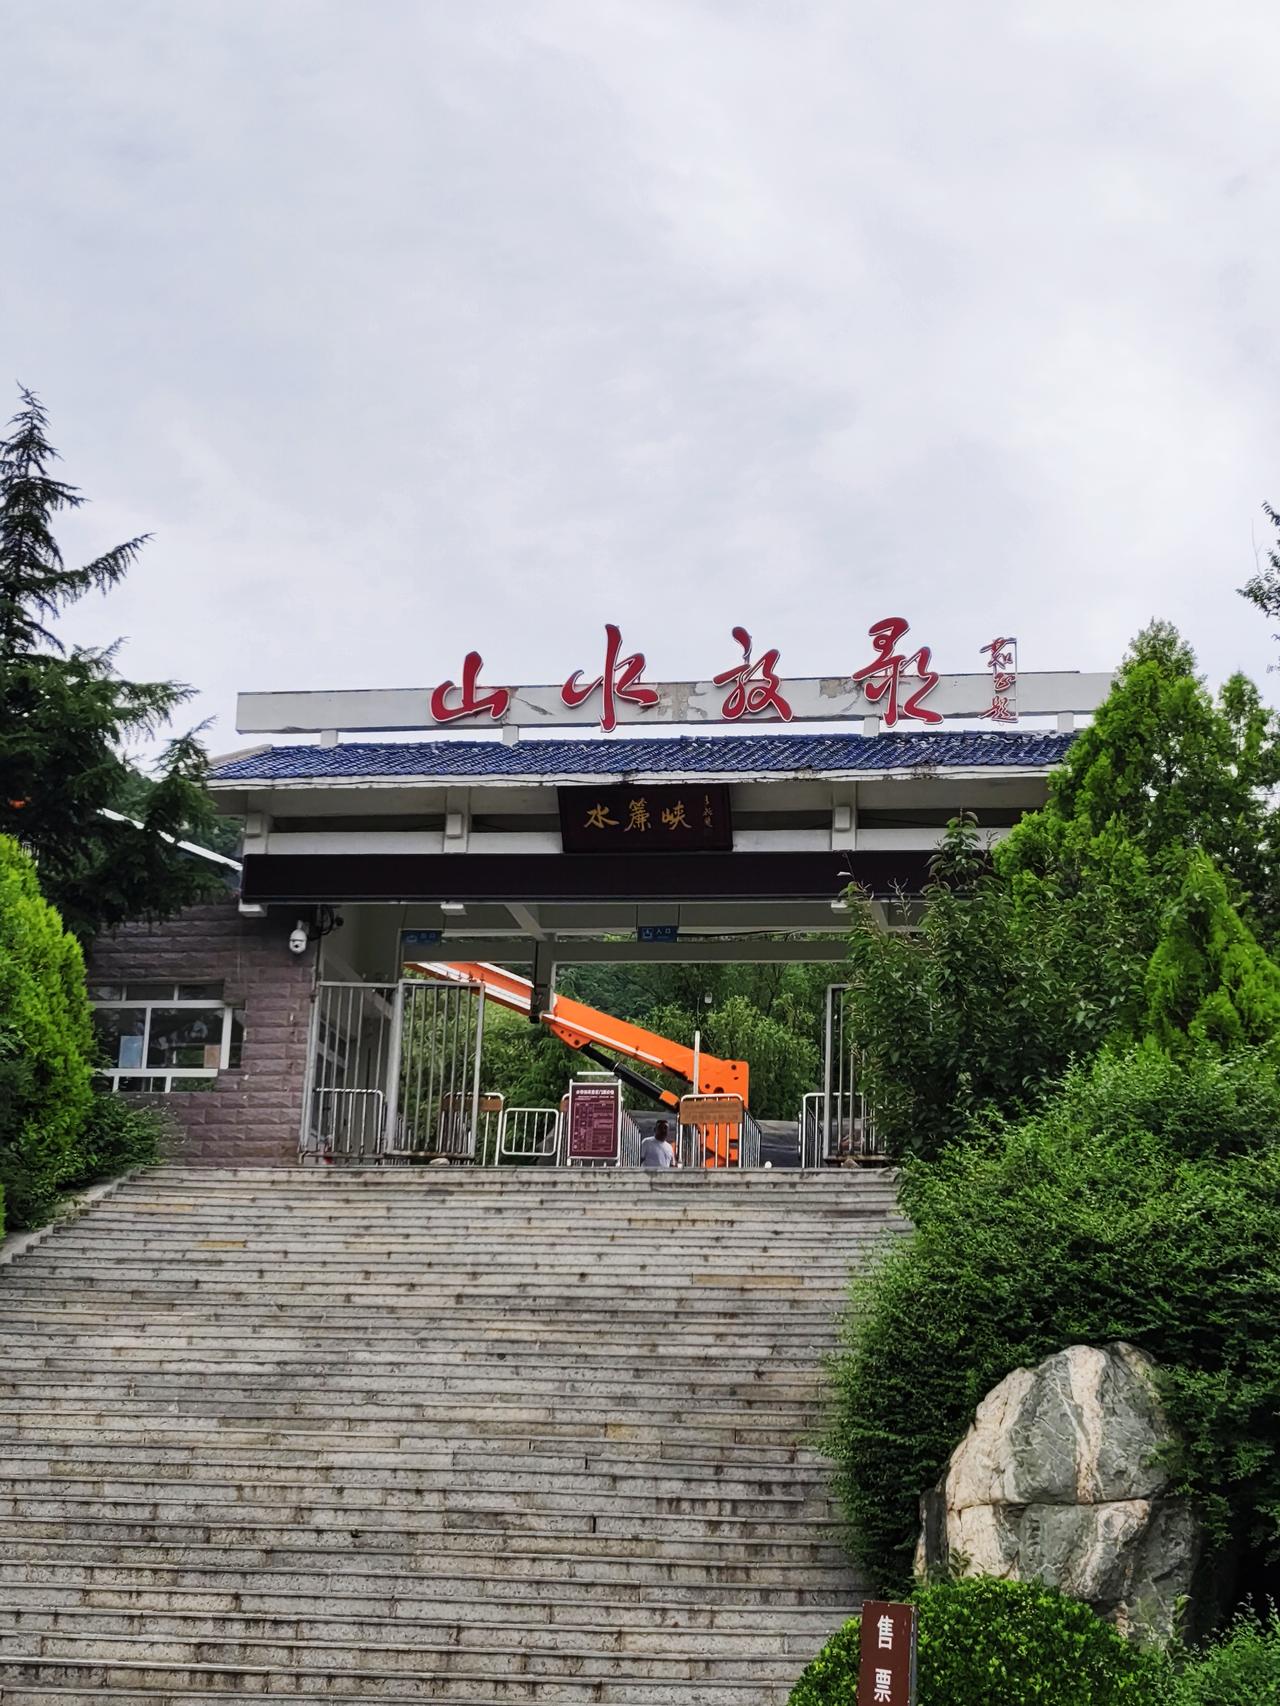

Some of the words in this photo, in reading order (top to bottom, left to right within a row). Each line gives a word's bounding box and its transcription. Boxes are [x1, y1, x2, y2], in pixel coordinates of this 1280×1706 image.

[430, 617, 945, 733] 山水放歌
[874, 1614, 895, 1703] 售票
